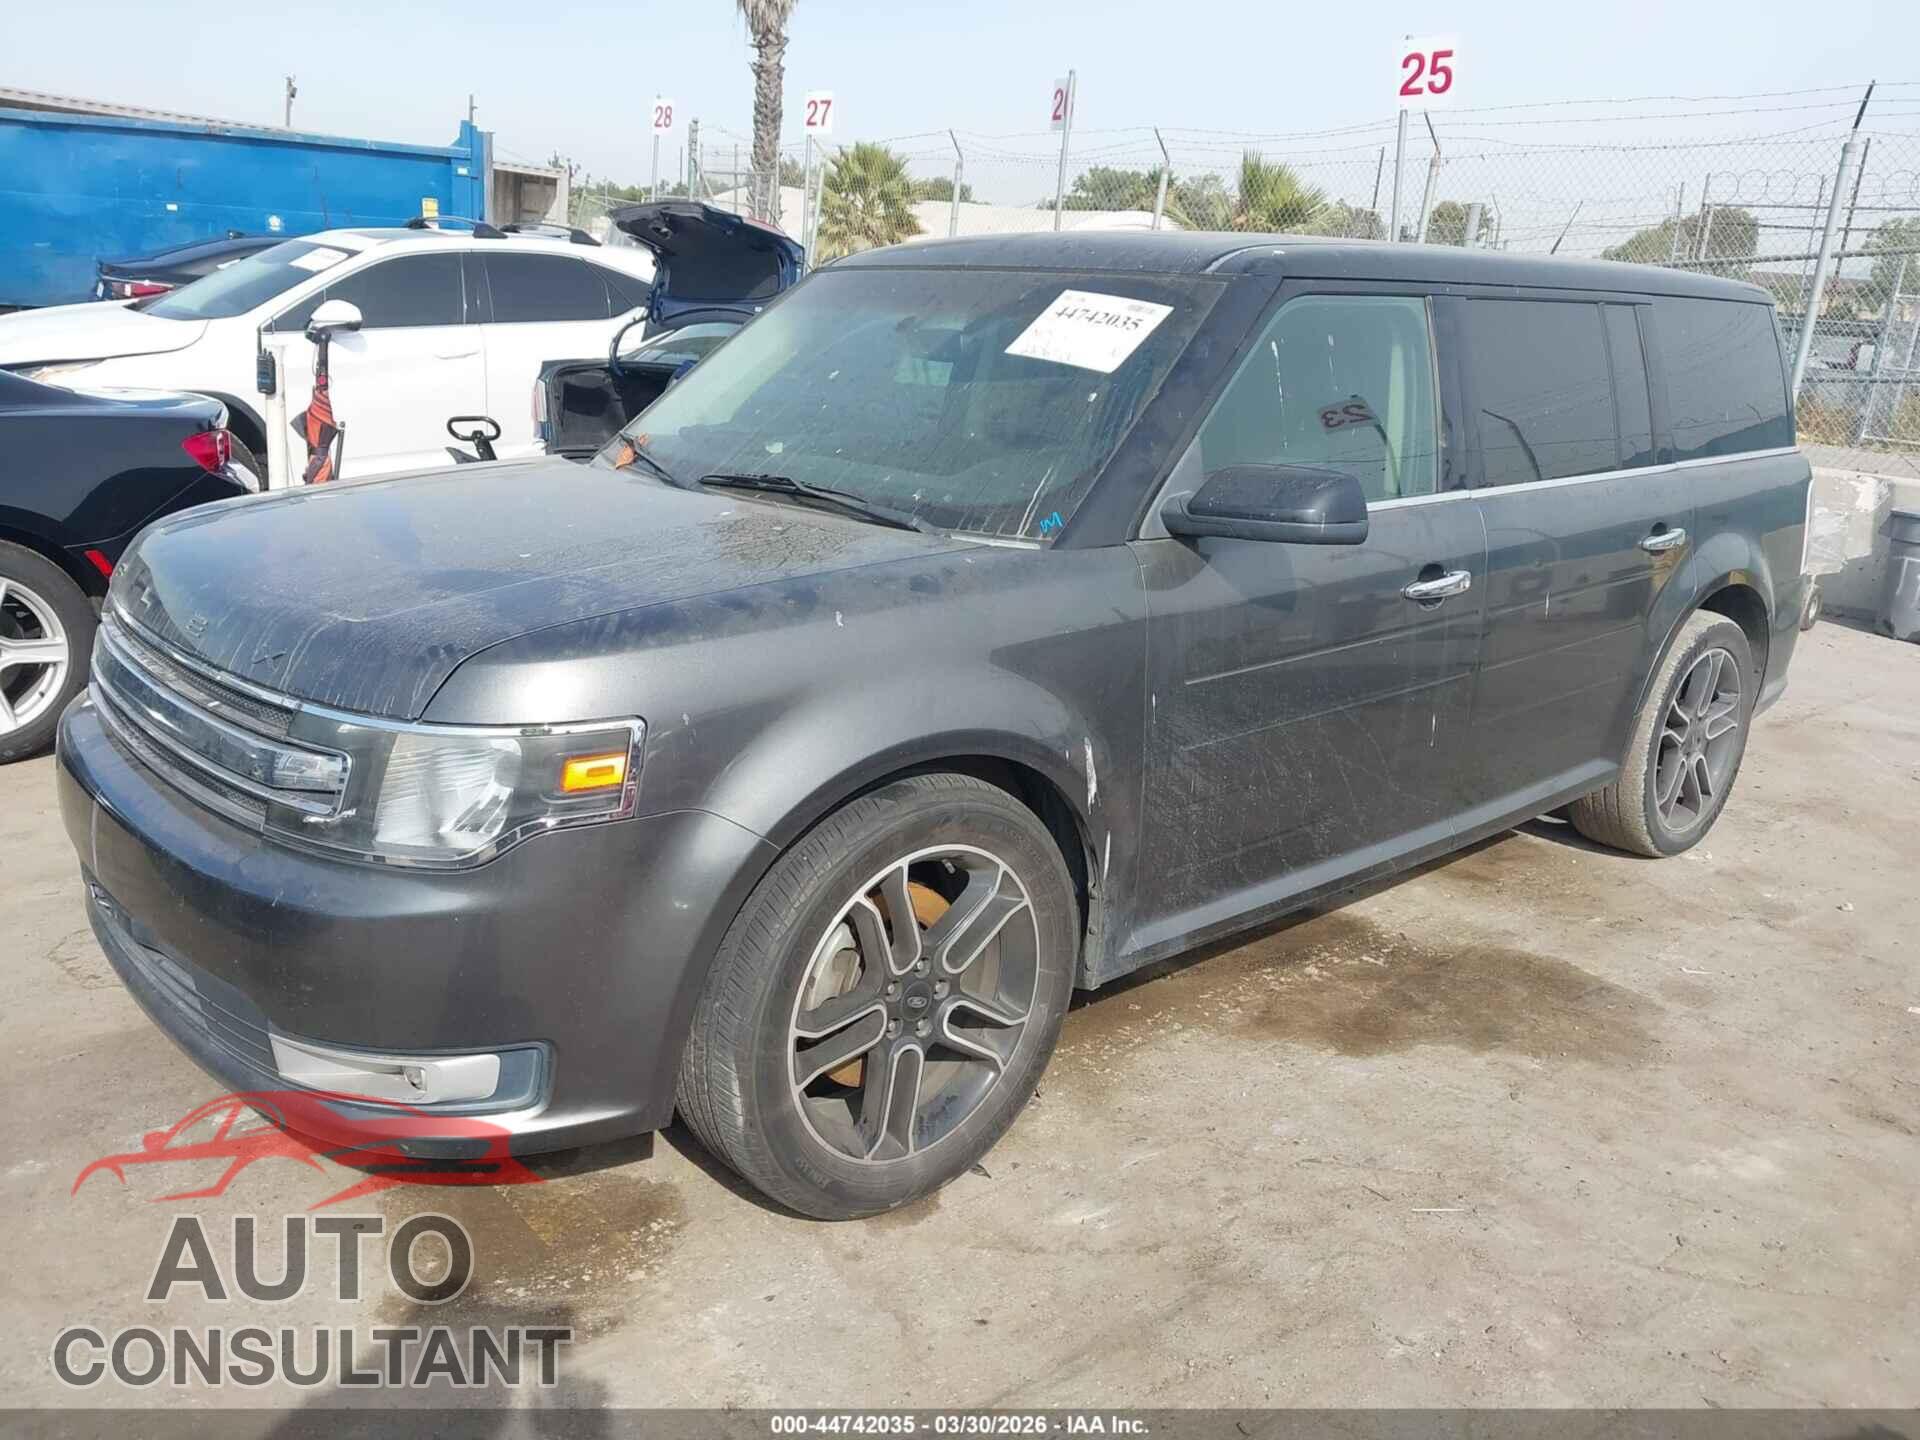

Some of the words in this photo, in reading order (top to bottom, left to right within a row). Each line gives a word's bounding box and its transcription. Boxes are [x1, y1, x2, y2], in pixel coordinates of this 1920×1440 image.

[1399, 49, 1453, 96] 25
[654, 105, 673, 128] 28
[806, 99, 832, 127] 27
[1052, 87, 1069, 121] 2
[1055, 305, 1145, 331] 44742035
